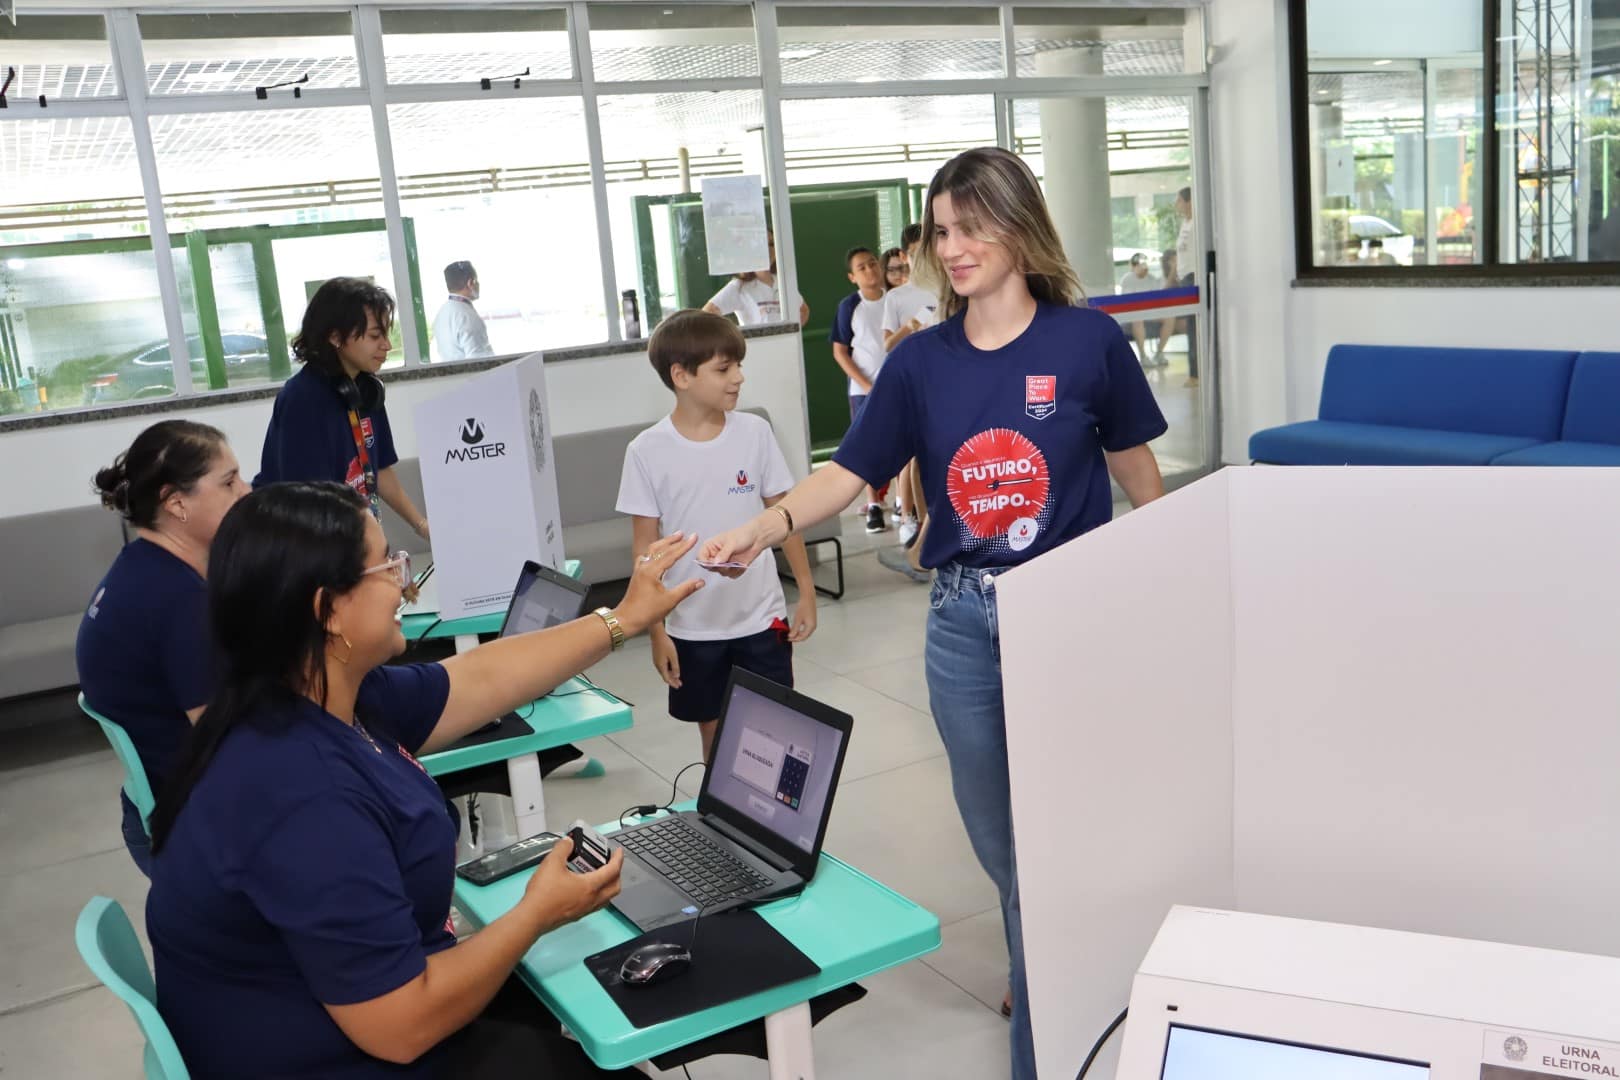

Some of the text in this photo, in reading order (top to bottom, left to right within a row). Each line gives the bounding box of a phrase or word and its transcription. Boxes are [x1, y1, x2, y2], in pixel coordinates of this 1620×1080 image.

[445, 442, 506, 464] MASTER
[961, 458, 1038, 483] FUTURO,
[969, 493, 1031, 515] TEMPO.
[1561, 1045, 1600, 1060] URNA
[1542, 1056, 1620, 1077] ELEITORAL
